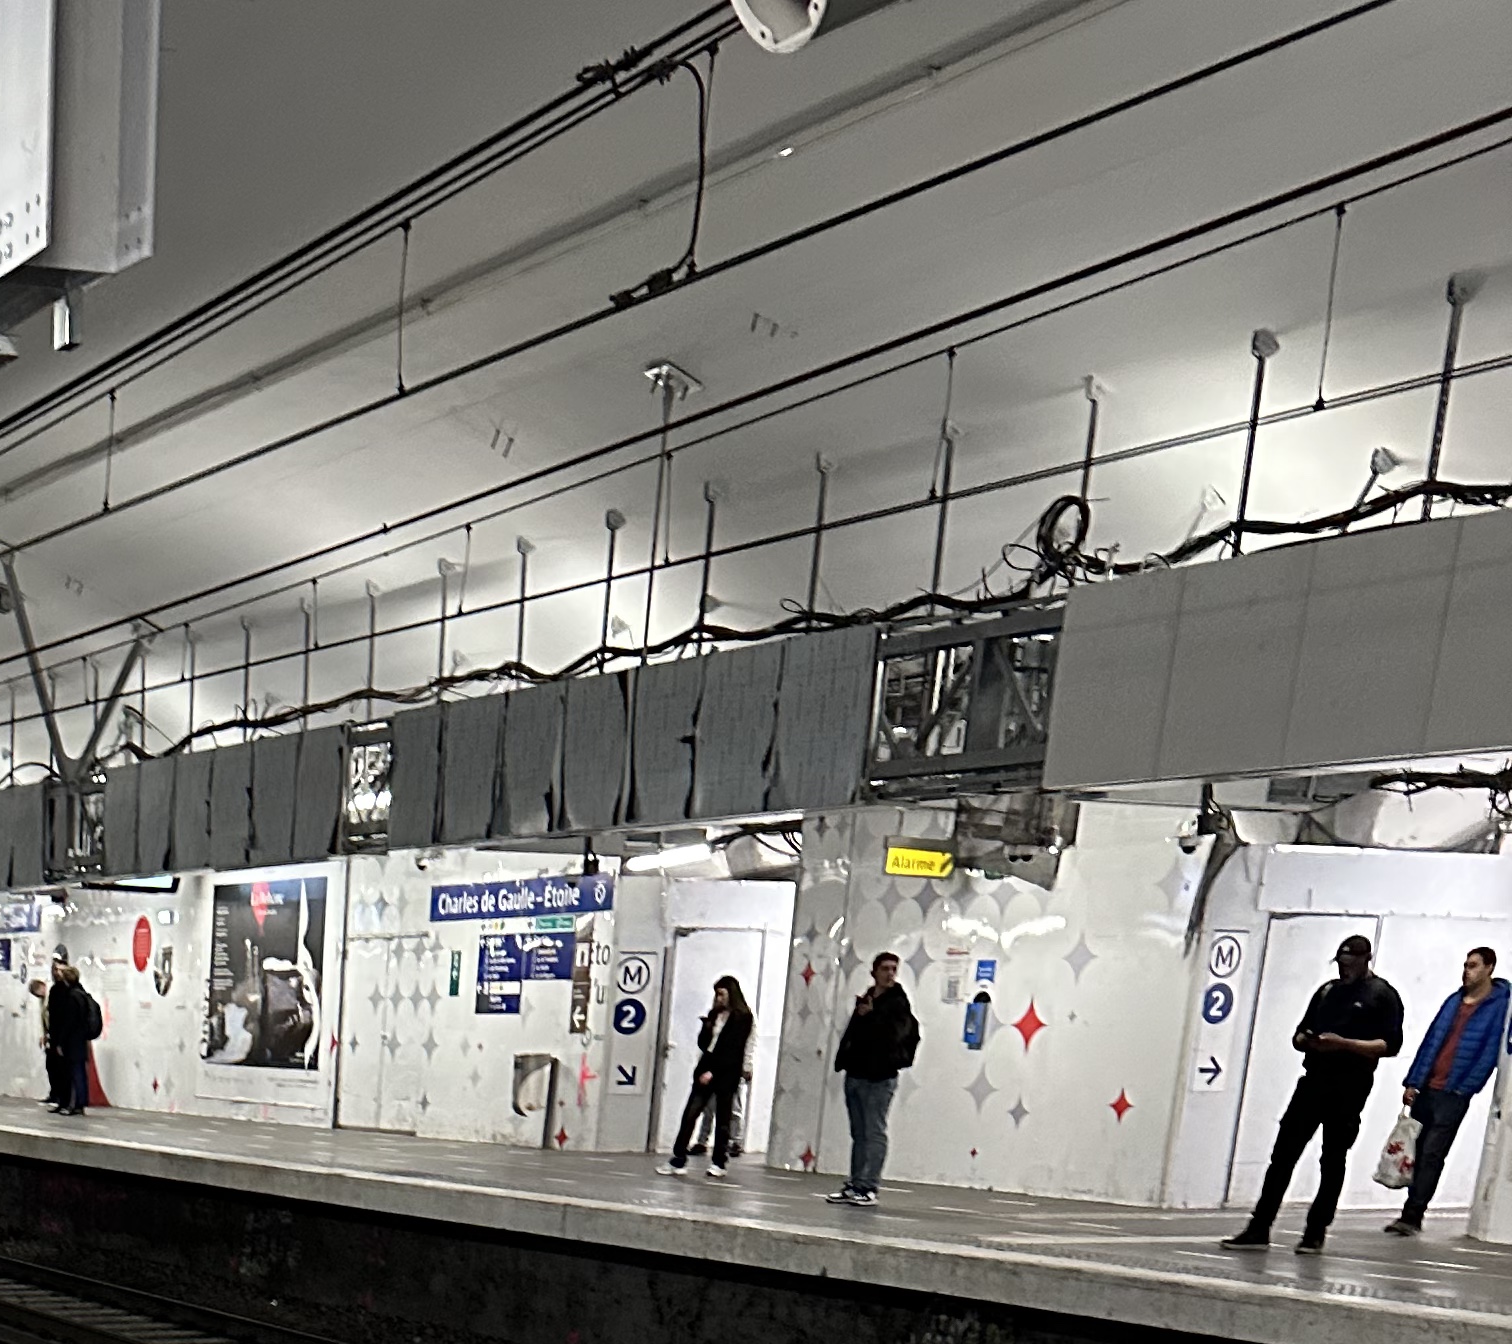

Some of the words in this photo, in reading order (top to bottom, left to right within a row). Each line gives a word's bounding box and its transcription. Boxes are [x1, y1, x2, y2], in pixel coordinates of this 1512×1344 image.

[891, 855, 936, 871] Alarme
[437, 890, 479, 915] Charles
[480, 889, 496, 913] de
[1209, 990, 1226, 1017] 2
[619, 1004, 637, 1029] 2
